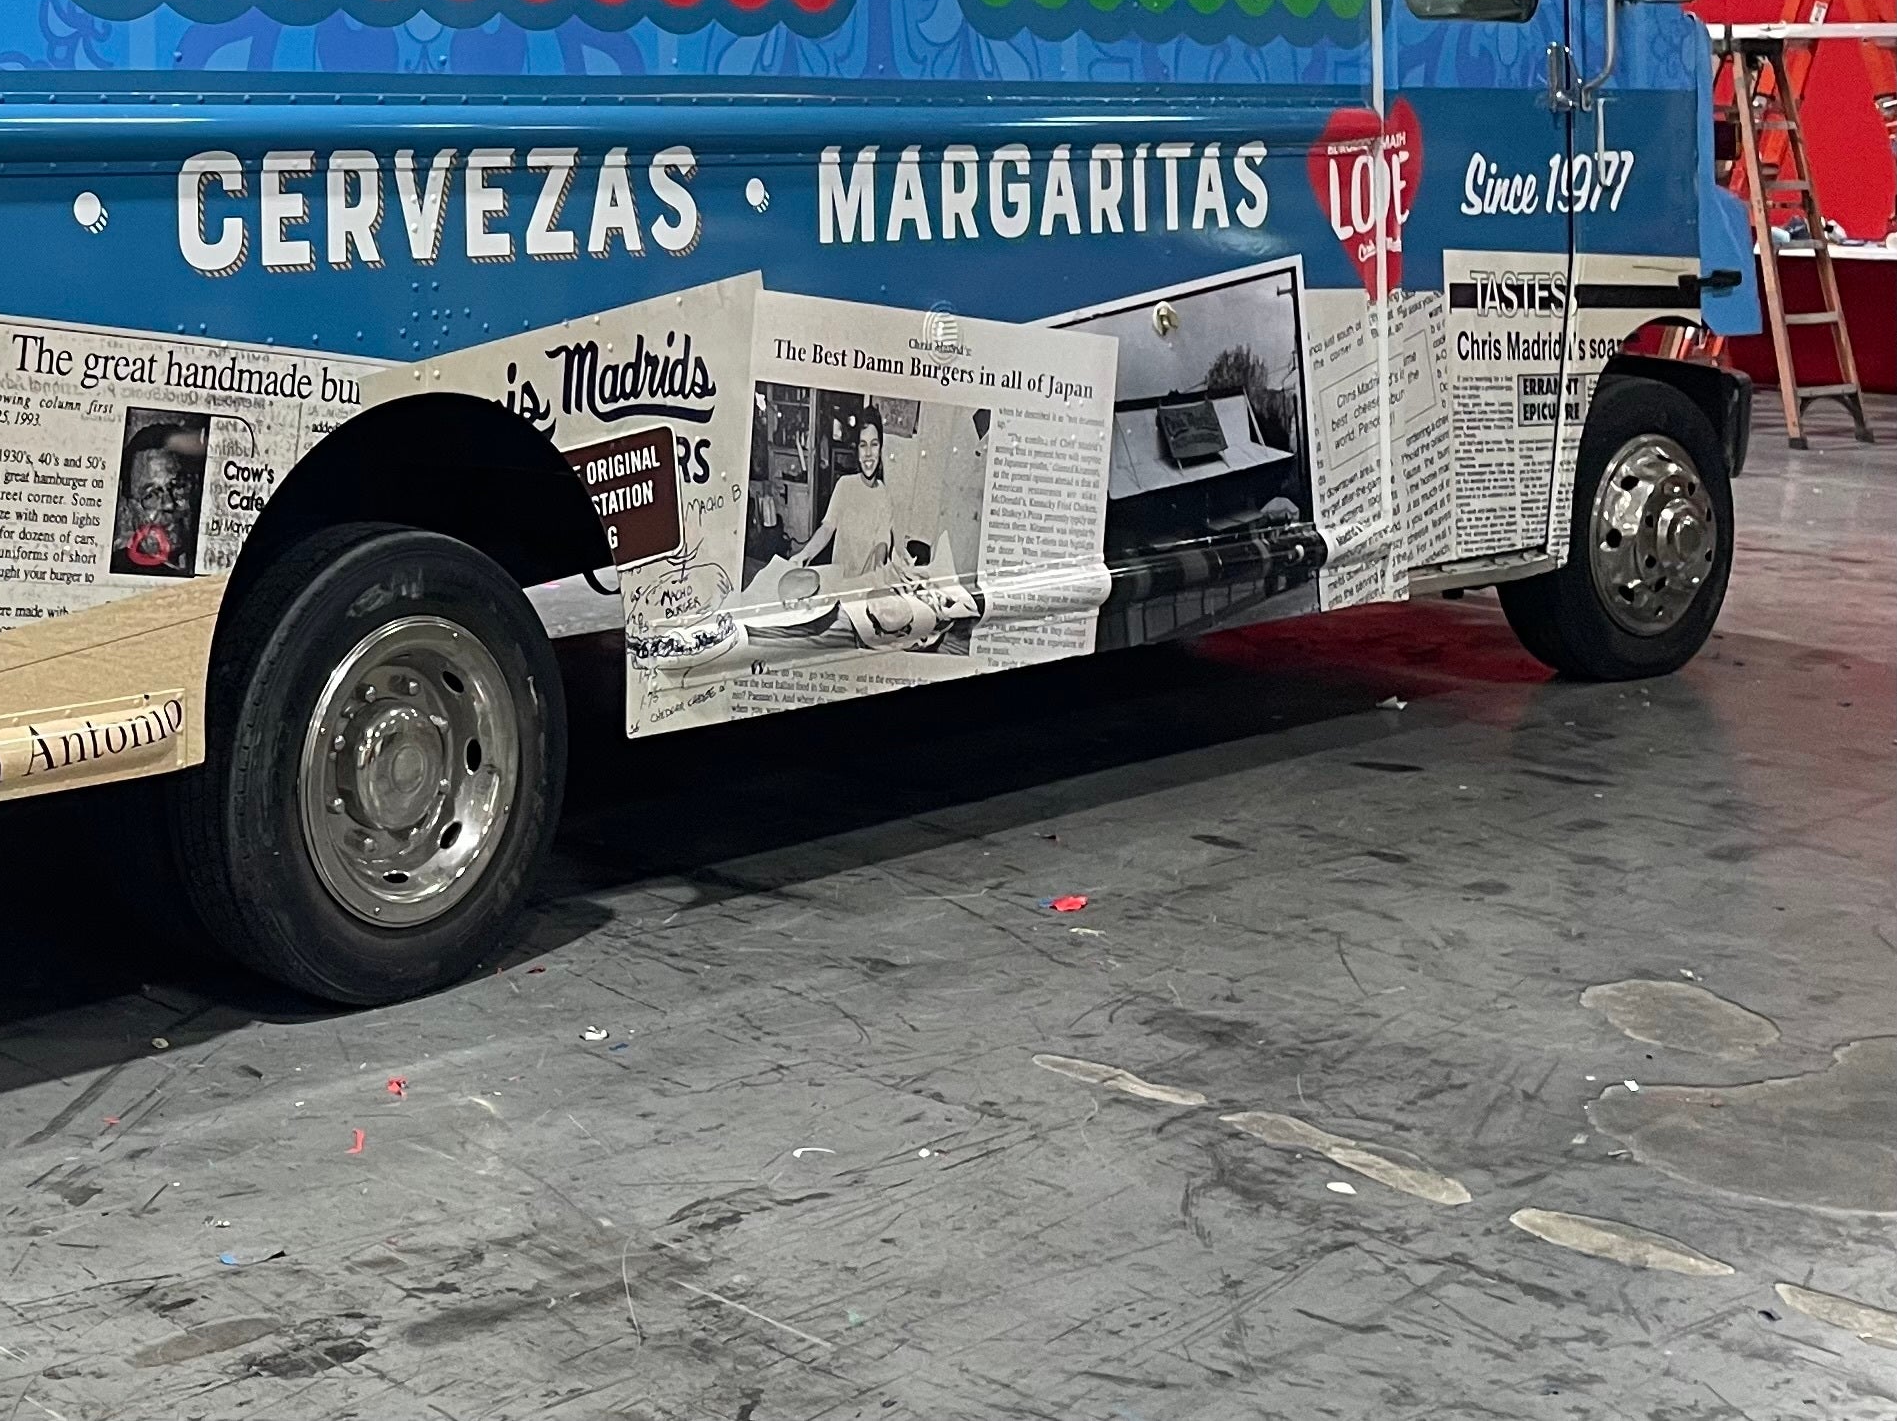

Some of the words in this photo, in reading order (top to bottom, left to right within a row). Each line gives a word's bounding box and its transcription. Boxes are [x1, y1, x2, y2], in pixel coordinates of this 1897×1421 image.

[1461, 152, 1539, 216] Since
[1546, 150, 1634, 213] 1977
[1329, 151, 1410, 240] LOE
[177, 146, 701, 276] CERVEZAS
[818, 140, 1268, 244] MARGARITAS
[1470, 271, 1578, 318] TASTES
[1457, 331, 1501, 362] Chris
[1506, 331, 1586, 362] Madrid's
[13, 335, 73, 376] The
[81, 354, 157, 389] great
[164, 350, 313, 399] handmade
[545, 331, 717, 424] Madrids
[775, 338, 807, 362] The
[812, 344, 847, 368] Best
[854, 350, 904, 376] Damn
[910, 358, 974, 387] Burgers
[979, 366, 996, 386] in
[1001, 370, 1022, 390] all
[1027, 373, 1044, 393] of
[1046, 376, 1094, 401] Japan
[39, 397, 80, 411] column
[87, 401, 113, 415] first
[15, 412, 42, 427] 1993.
[38, 453, 59, 466] 40's
[64, 456, 82, 468] and
[85, 456, 106, 470] 50's
[224, 460, 275, 484] Crow's
[586, 445, 661, 485] ORIGINAL
[4, 471, 29, 485] great
[34, 471, 88, 490] hamburger
[92, 479, 103, 488] on
[71, 493, 102, 507] Some
[227, 489, 265, 511] Cafe
[15, 508, 38, 522] with
[42, 514, 67, 524] neon
[72, 512, 100, 528] lights
[0, 525, 15, 539] for
[19, 527, 55, 542] dozens
[59, 530, 72, 543] of
[74, 535, 98, 547] cars,
[53, 550, 64, 562] of
[69, 550, 96, 564] short
[24, 568, 47, 581] your
[49, 568, 82, 585] burger
[85, 573, 94, 583] to
[15, 606, 43, 618] made
[21, 695, 185, 778] Antonio
